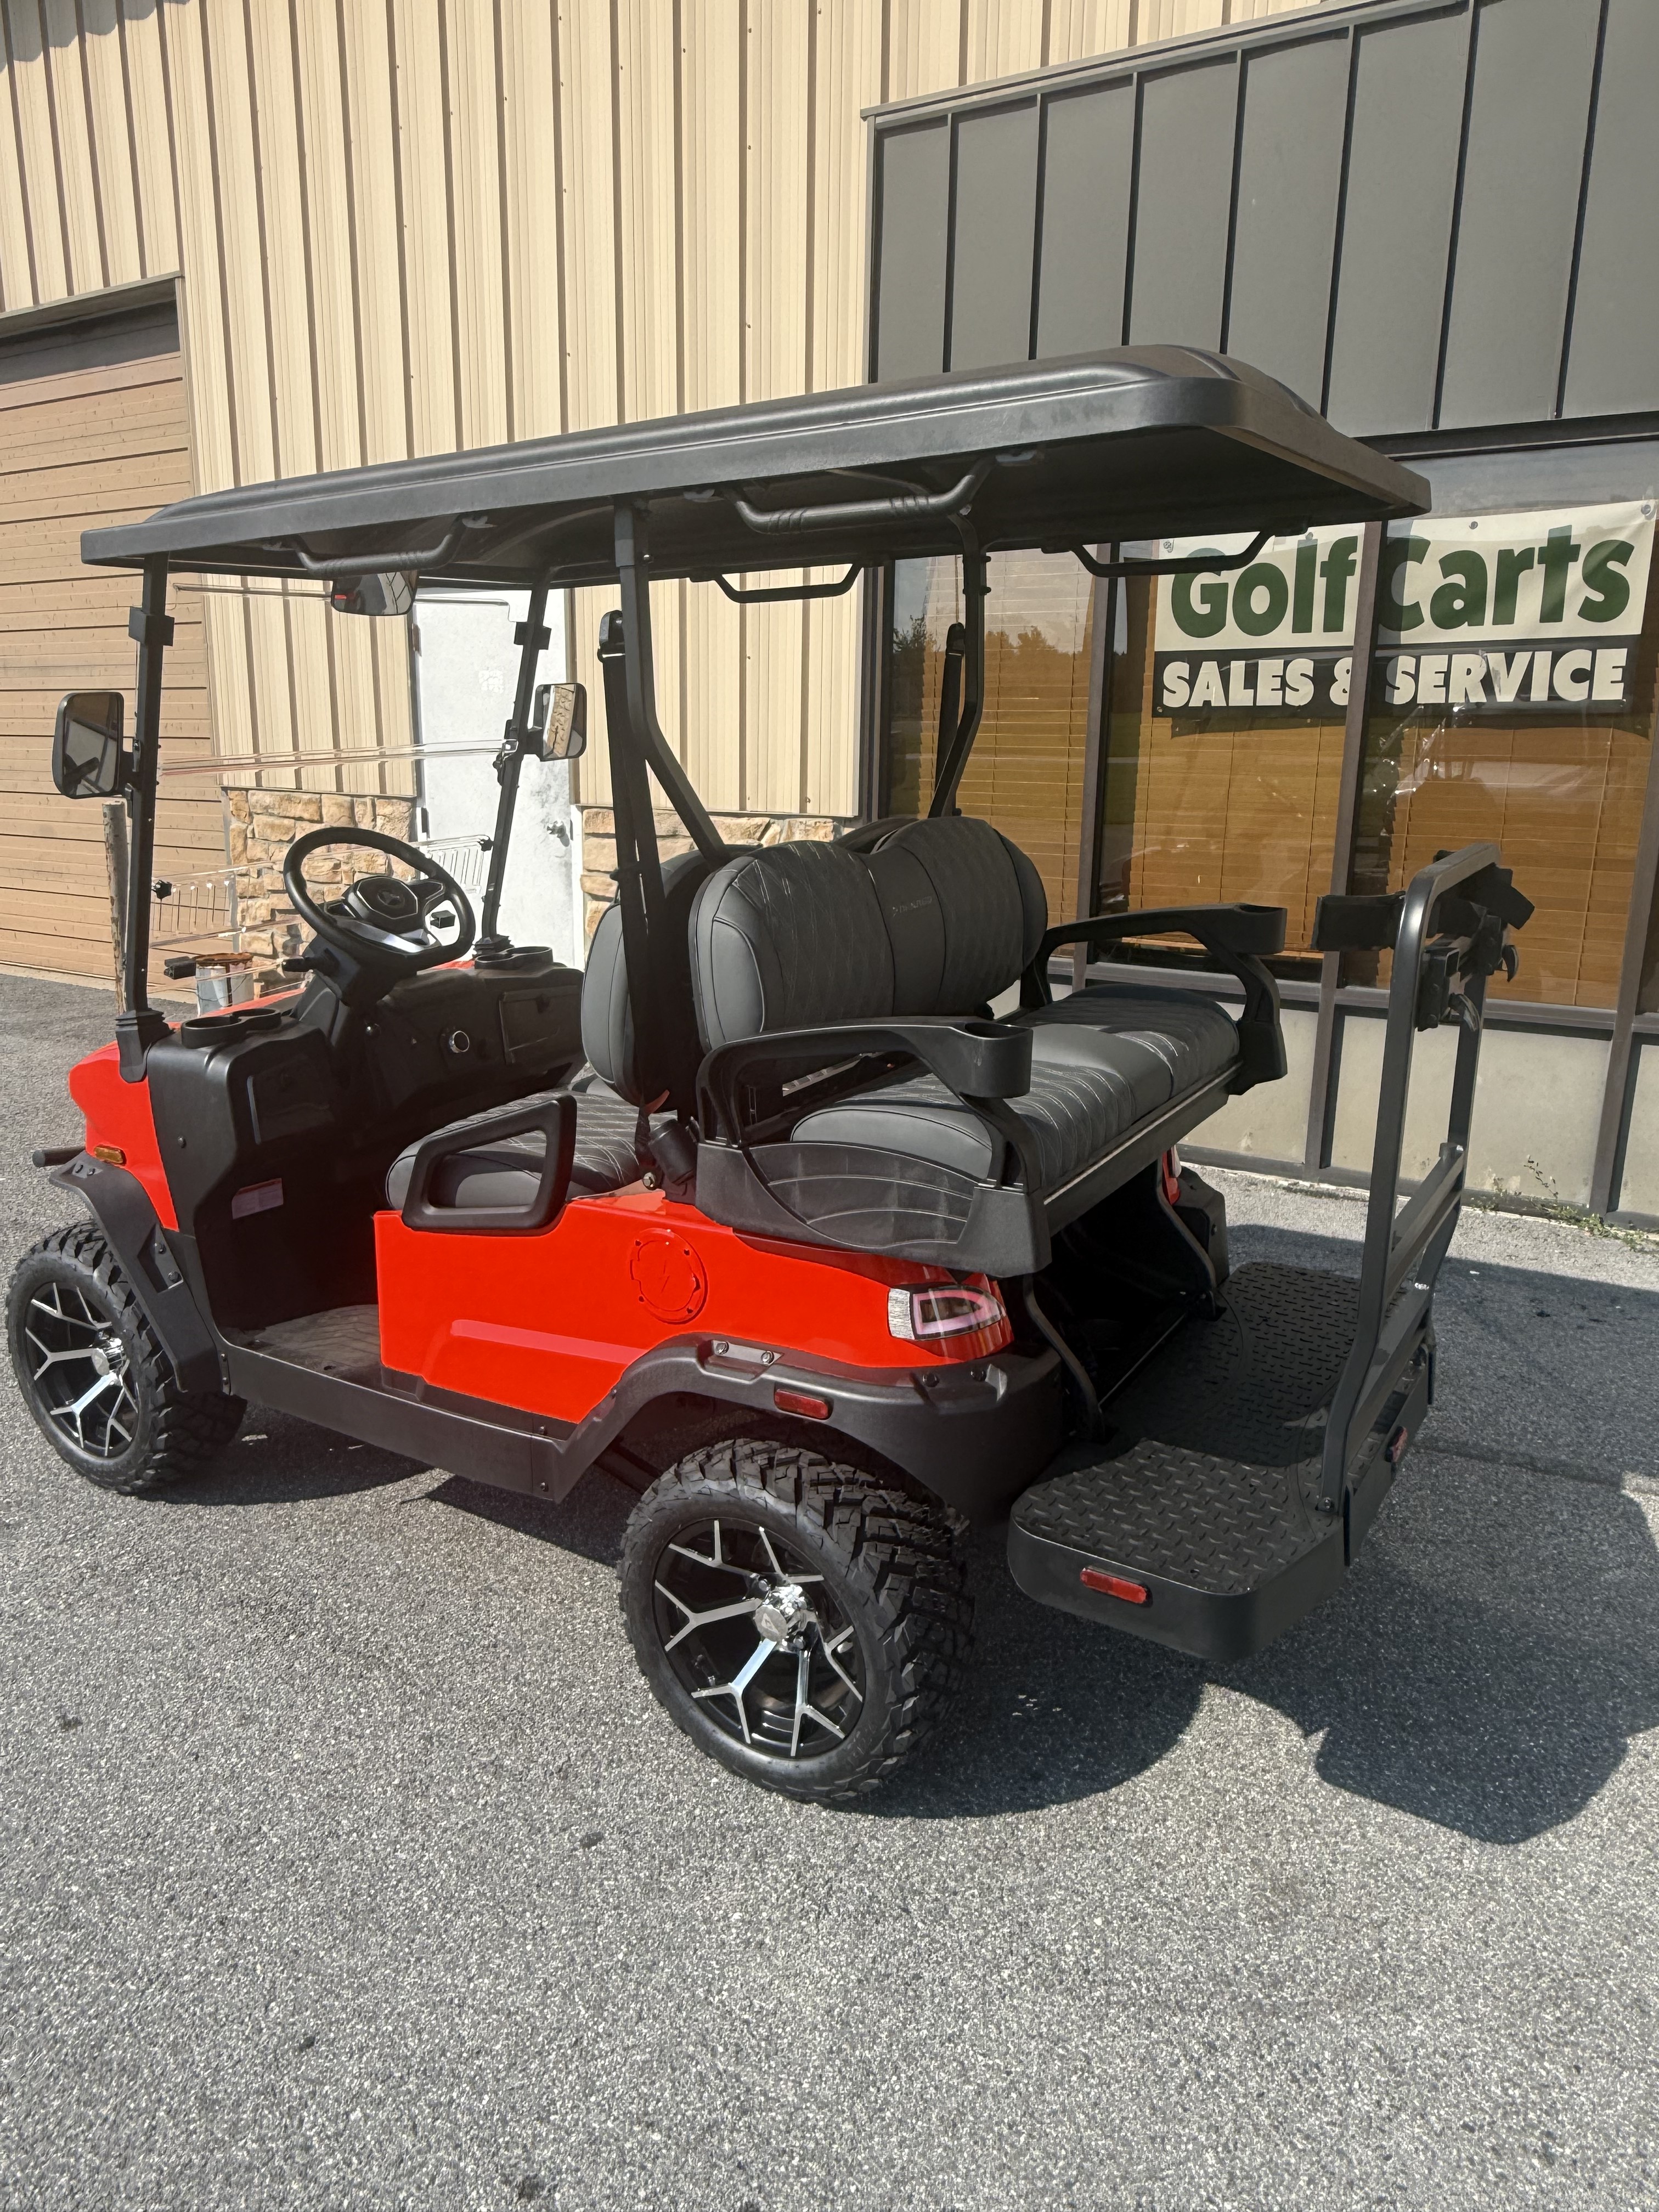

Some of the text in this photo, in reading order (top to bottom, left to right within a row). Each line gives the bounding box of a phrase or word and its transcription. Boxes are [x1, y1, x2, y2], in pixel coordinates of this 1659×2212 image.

[1171, 525, 1634, 638] Golf Carts
[1163, 648, 1627, 707] SALES & SERVICE
